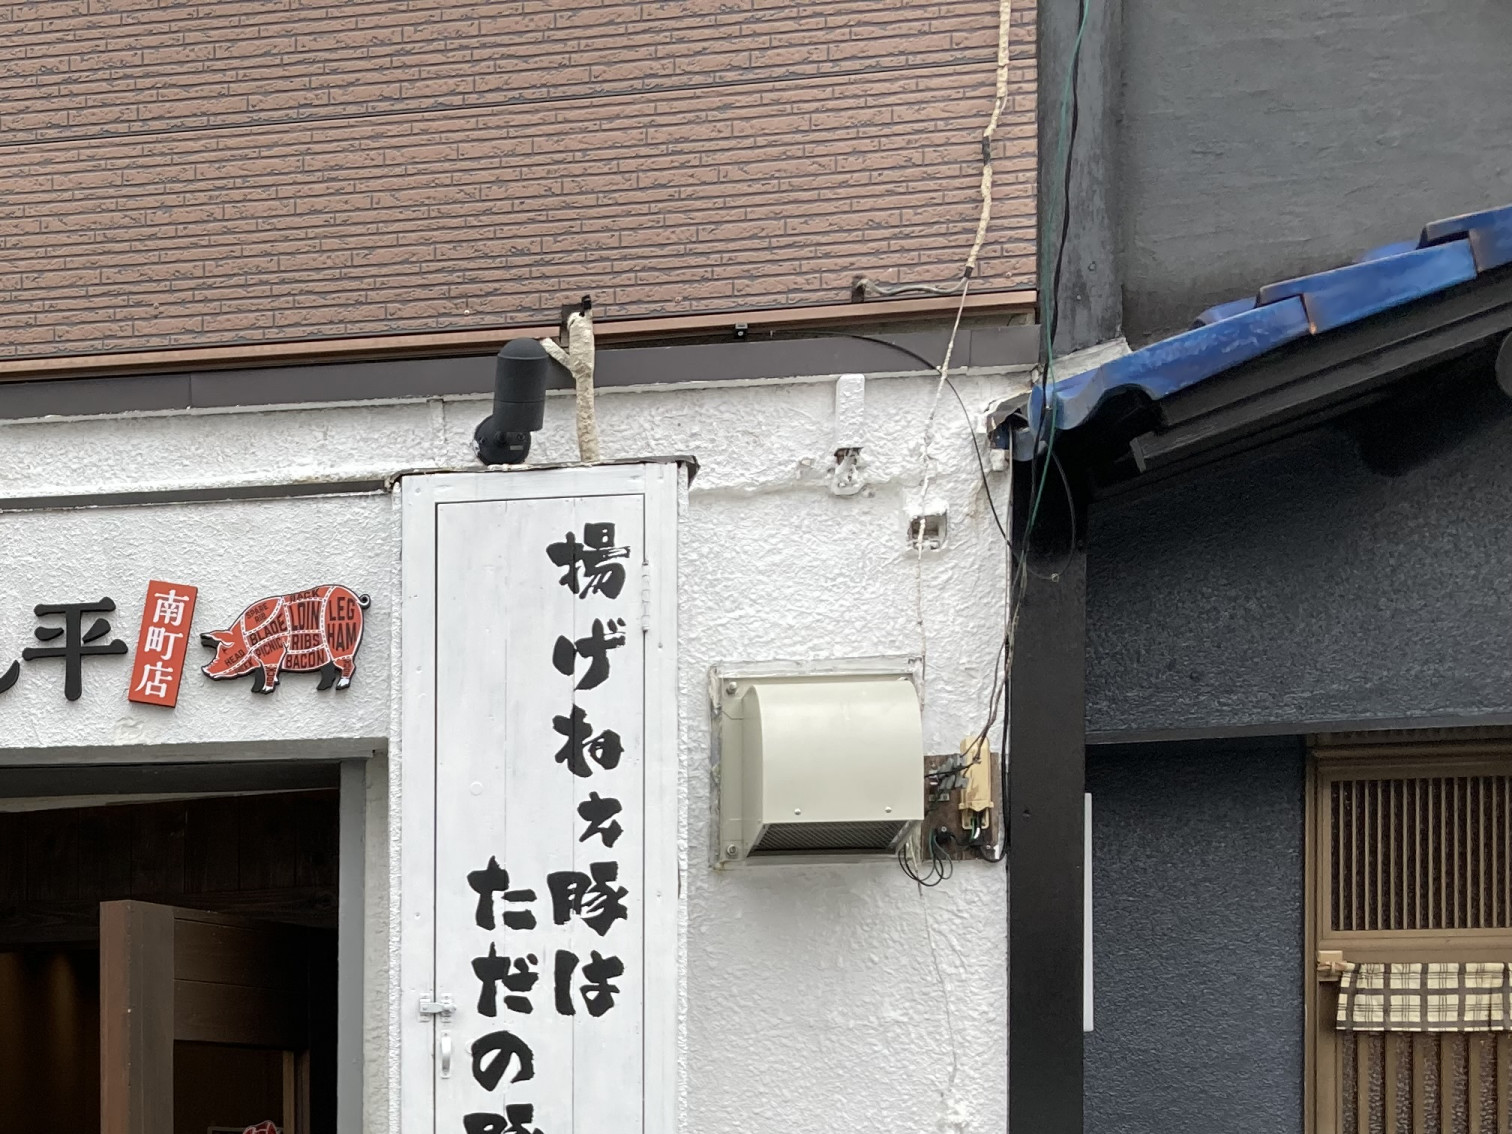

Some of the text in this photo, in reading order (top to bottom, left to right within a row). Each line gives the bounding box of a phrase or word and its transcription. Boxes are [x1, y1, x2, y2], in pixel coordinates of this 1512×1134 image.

[246, 602, 269, 619] SPARE
[290, 601, 320, 631] LOIN
[329, 597, 355, 621] LEG
[250, 613, 287, 645] BLADE
[327, 623, 357, 651] HAM
[134, 589, 190, 698] 南町店
[256, 637, 284, 659] PICNIC
[292, 634, 320, 650] RIBS
[224, 649, 245, 667] HEAD
[286, 648, 325, 668] BACON
